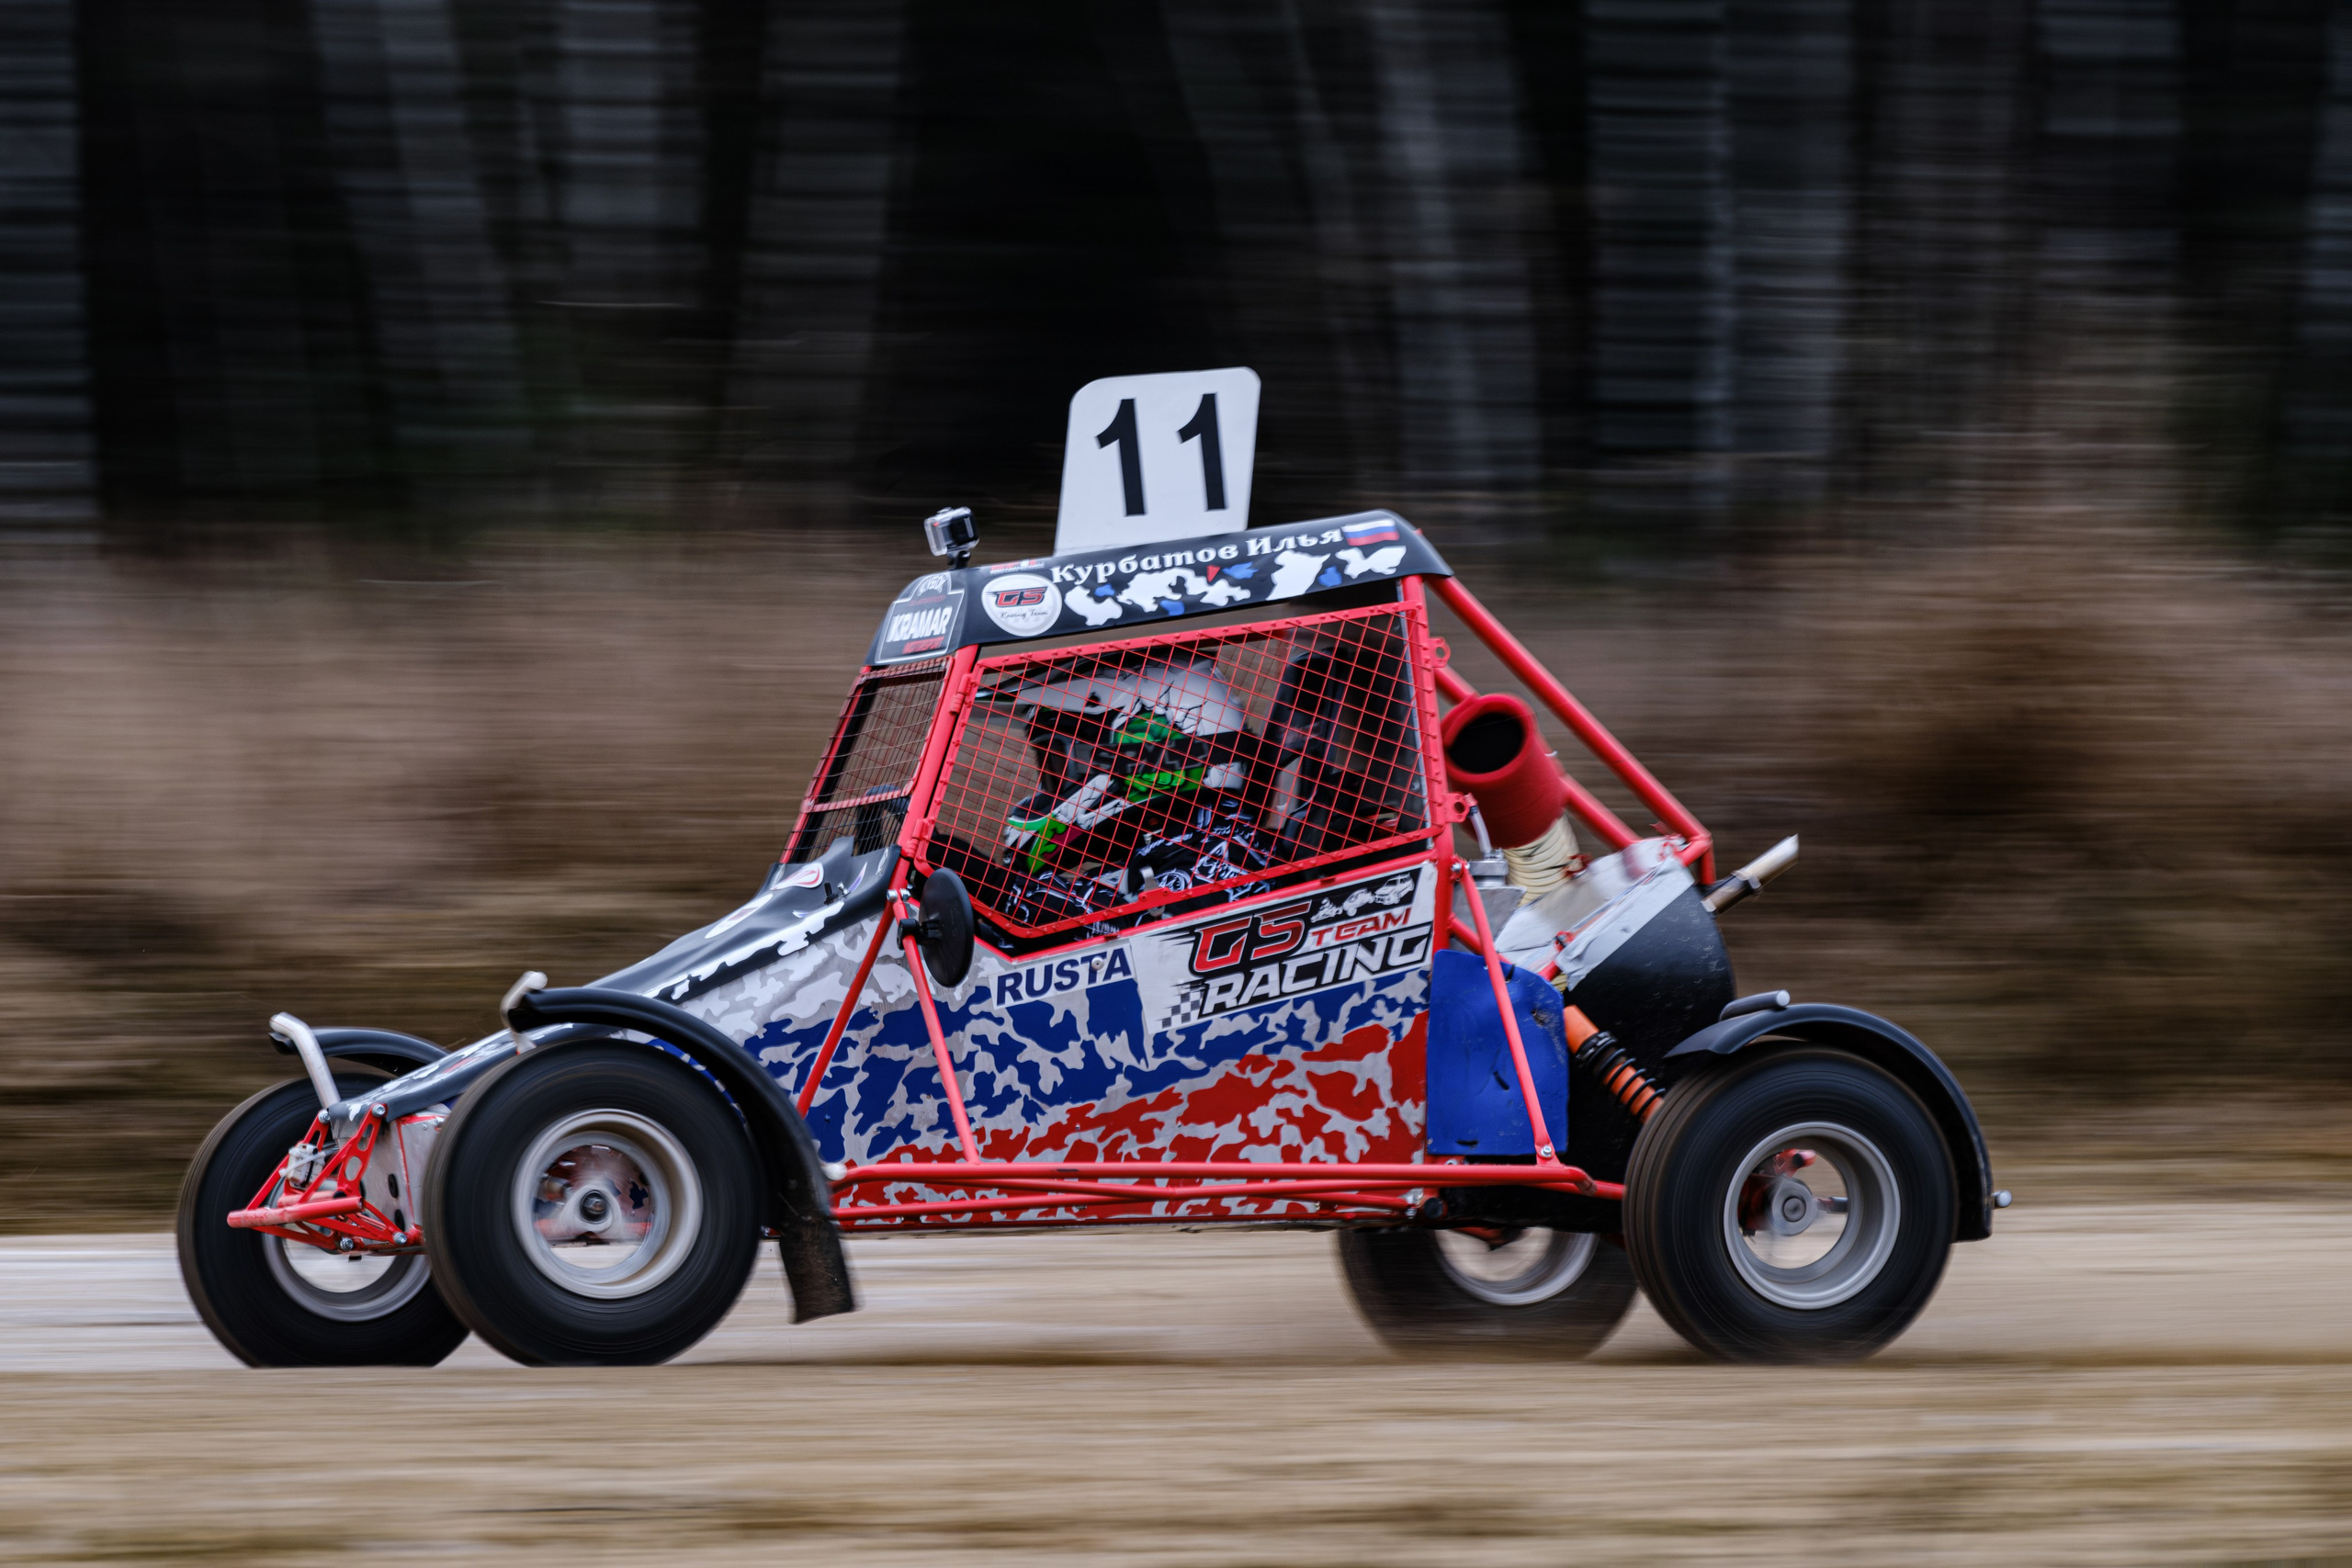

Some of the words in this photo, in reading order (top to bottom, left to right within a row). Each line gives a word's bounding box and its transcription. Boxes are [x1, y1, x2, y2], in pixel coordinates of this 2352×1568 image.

[1094, 391, 1229, 516] 11
[1050, 544, 1238, 585] Курбатов
[1245, 528, 1344, 557] Илья
[886, 606, 953, 642] KRAMAR
[995, 586, 1047, 607] GS
[1193, 901, 1311, 972] GS
[1309, 908, 1413, 948] TEAM
[996, 948, 1133, 1007] RUSTA
[1201, 924, 1431, 1015] RACING
